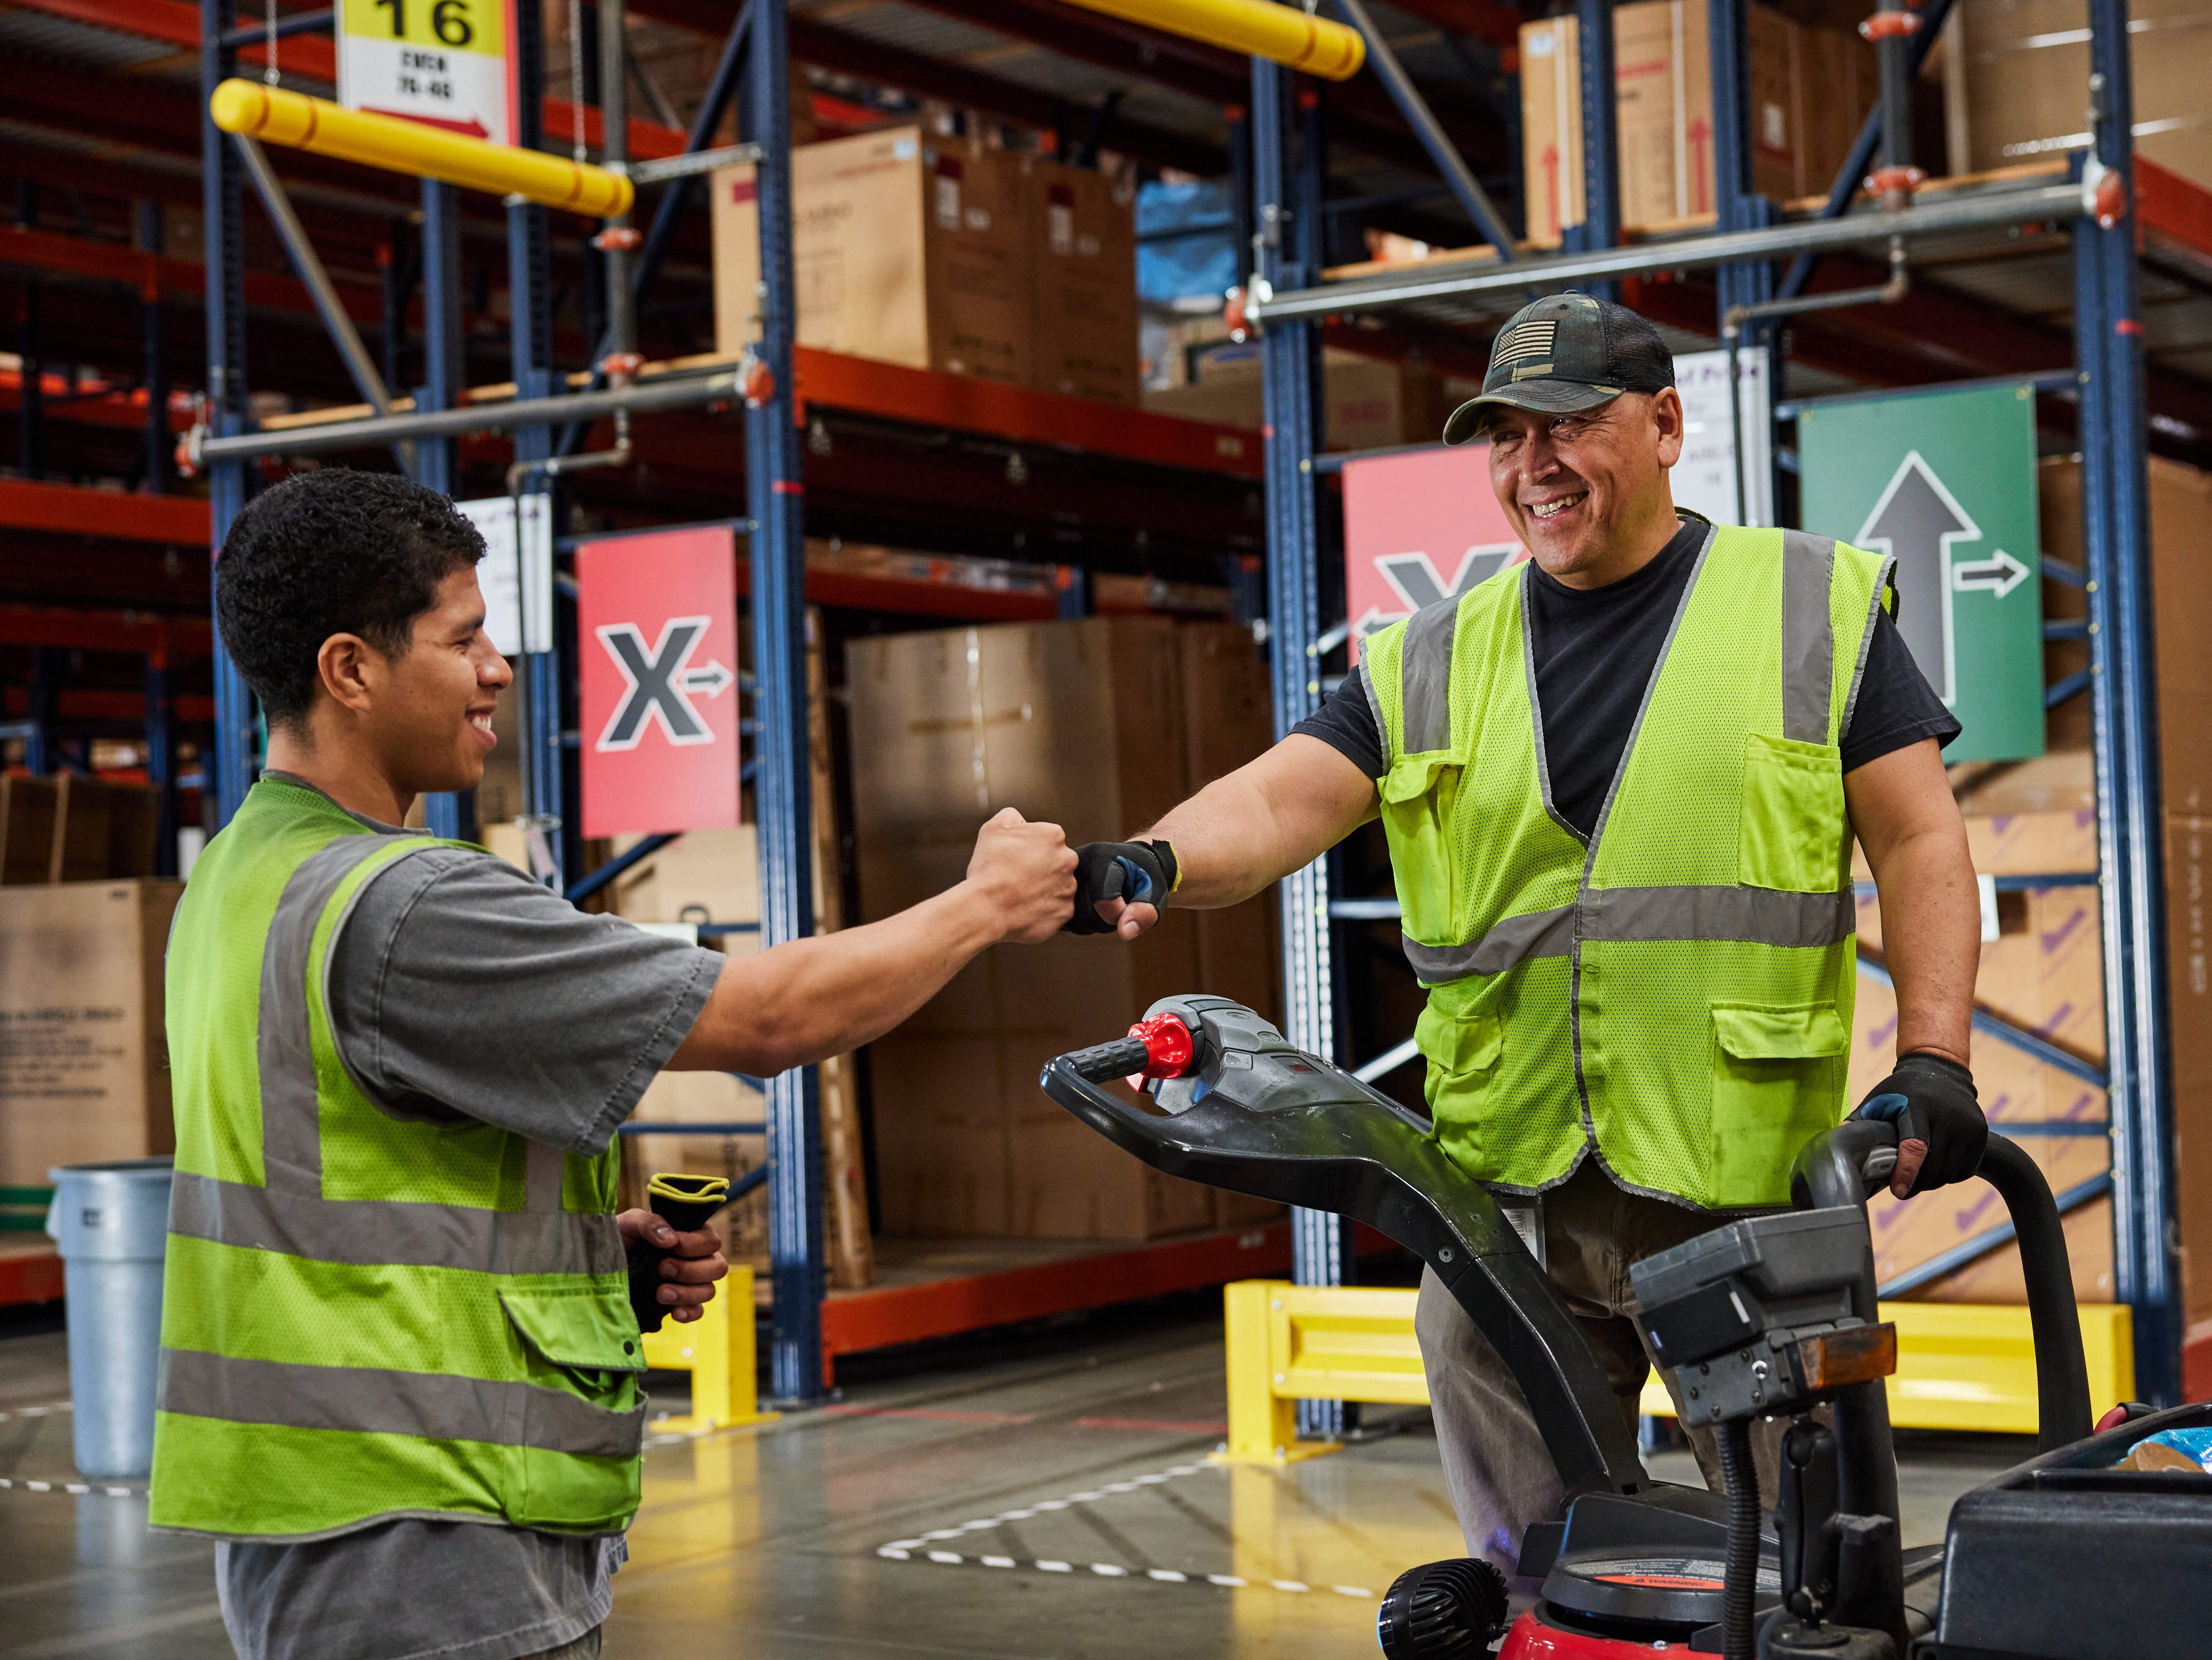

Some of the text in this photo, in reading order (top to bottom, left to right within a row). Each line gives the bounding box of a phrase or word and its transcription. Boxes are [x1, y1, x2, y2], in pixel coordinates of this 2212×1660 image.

[376, 0, 472, 46] 16
[594, 614, 715, 753] X
[1649, 1579, 1705, 1587] WARNING
